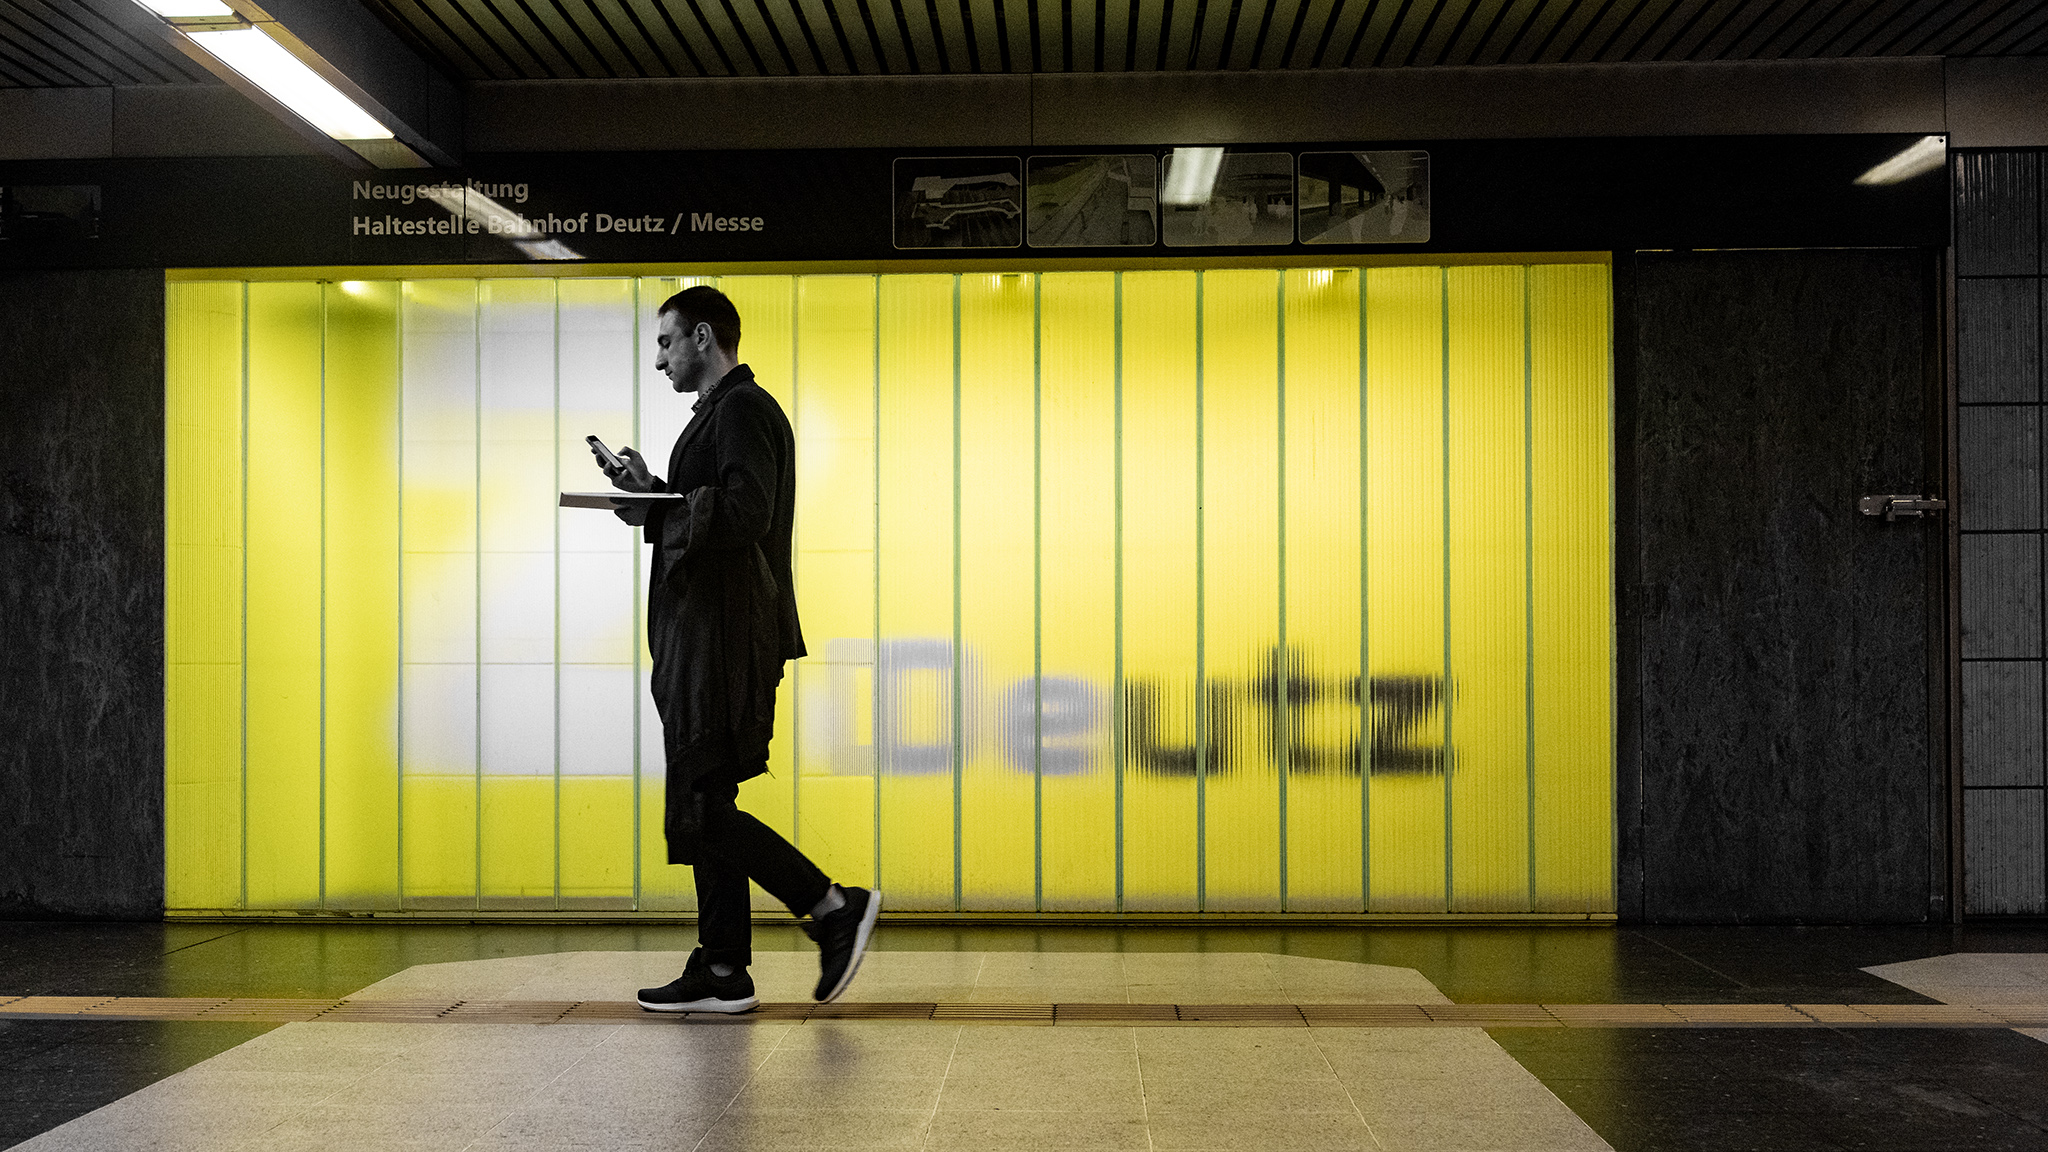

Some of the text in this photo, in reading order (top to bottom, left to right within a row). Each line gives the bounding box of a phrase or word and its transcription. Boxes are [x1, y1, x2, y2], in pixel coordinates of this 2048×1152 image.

[353, 178, 529, 203] Neugestaltung
[353, 212, 765, 235] Haltestelle Bahnhof Deutz / Messe
[823, 637, 1456, 778] Deutz
